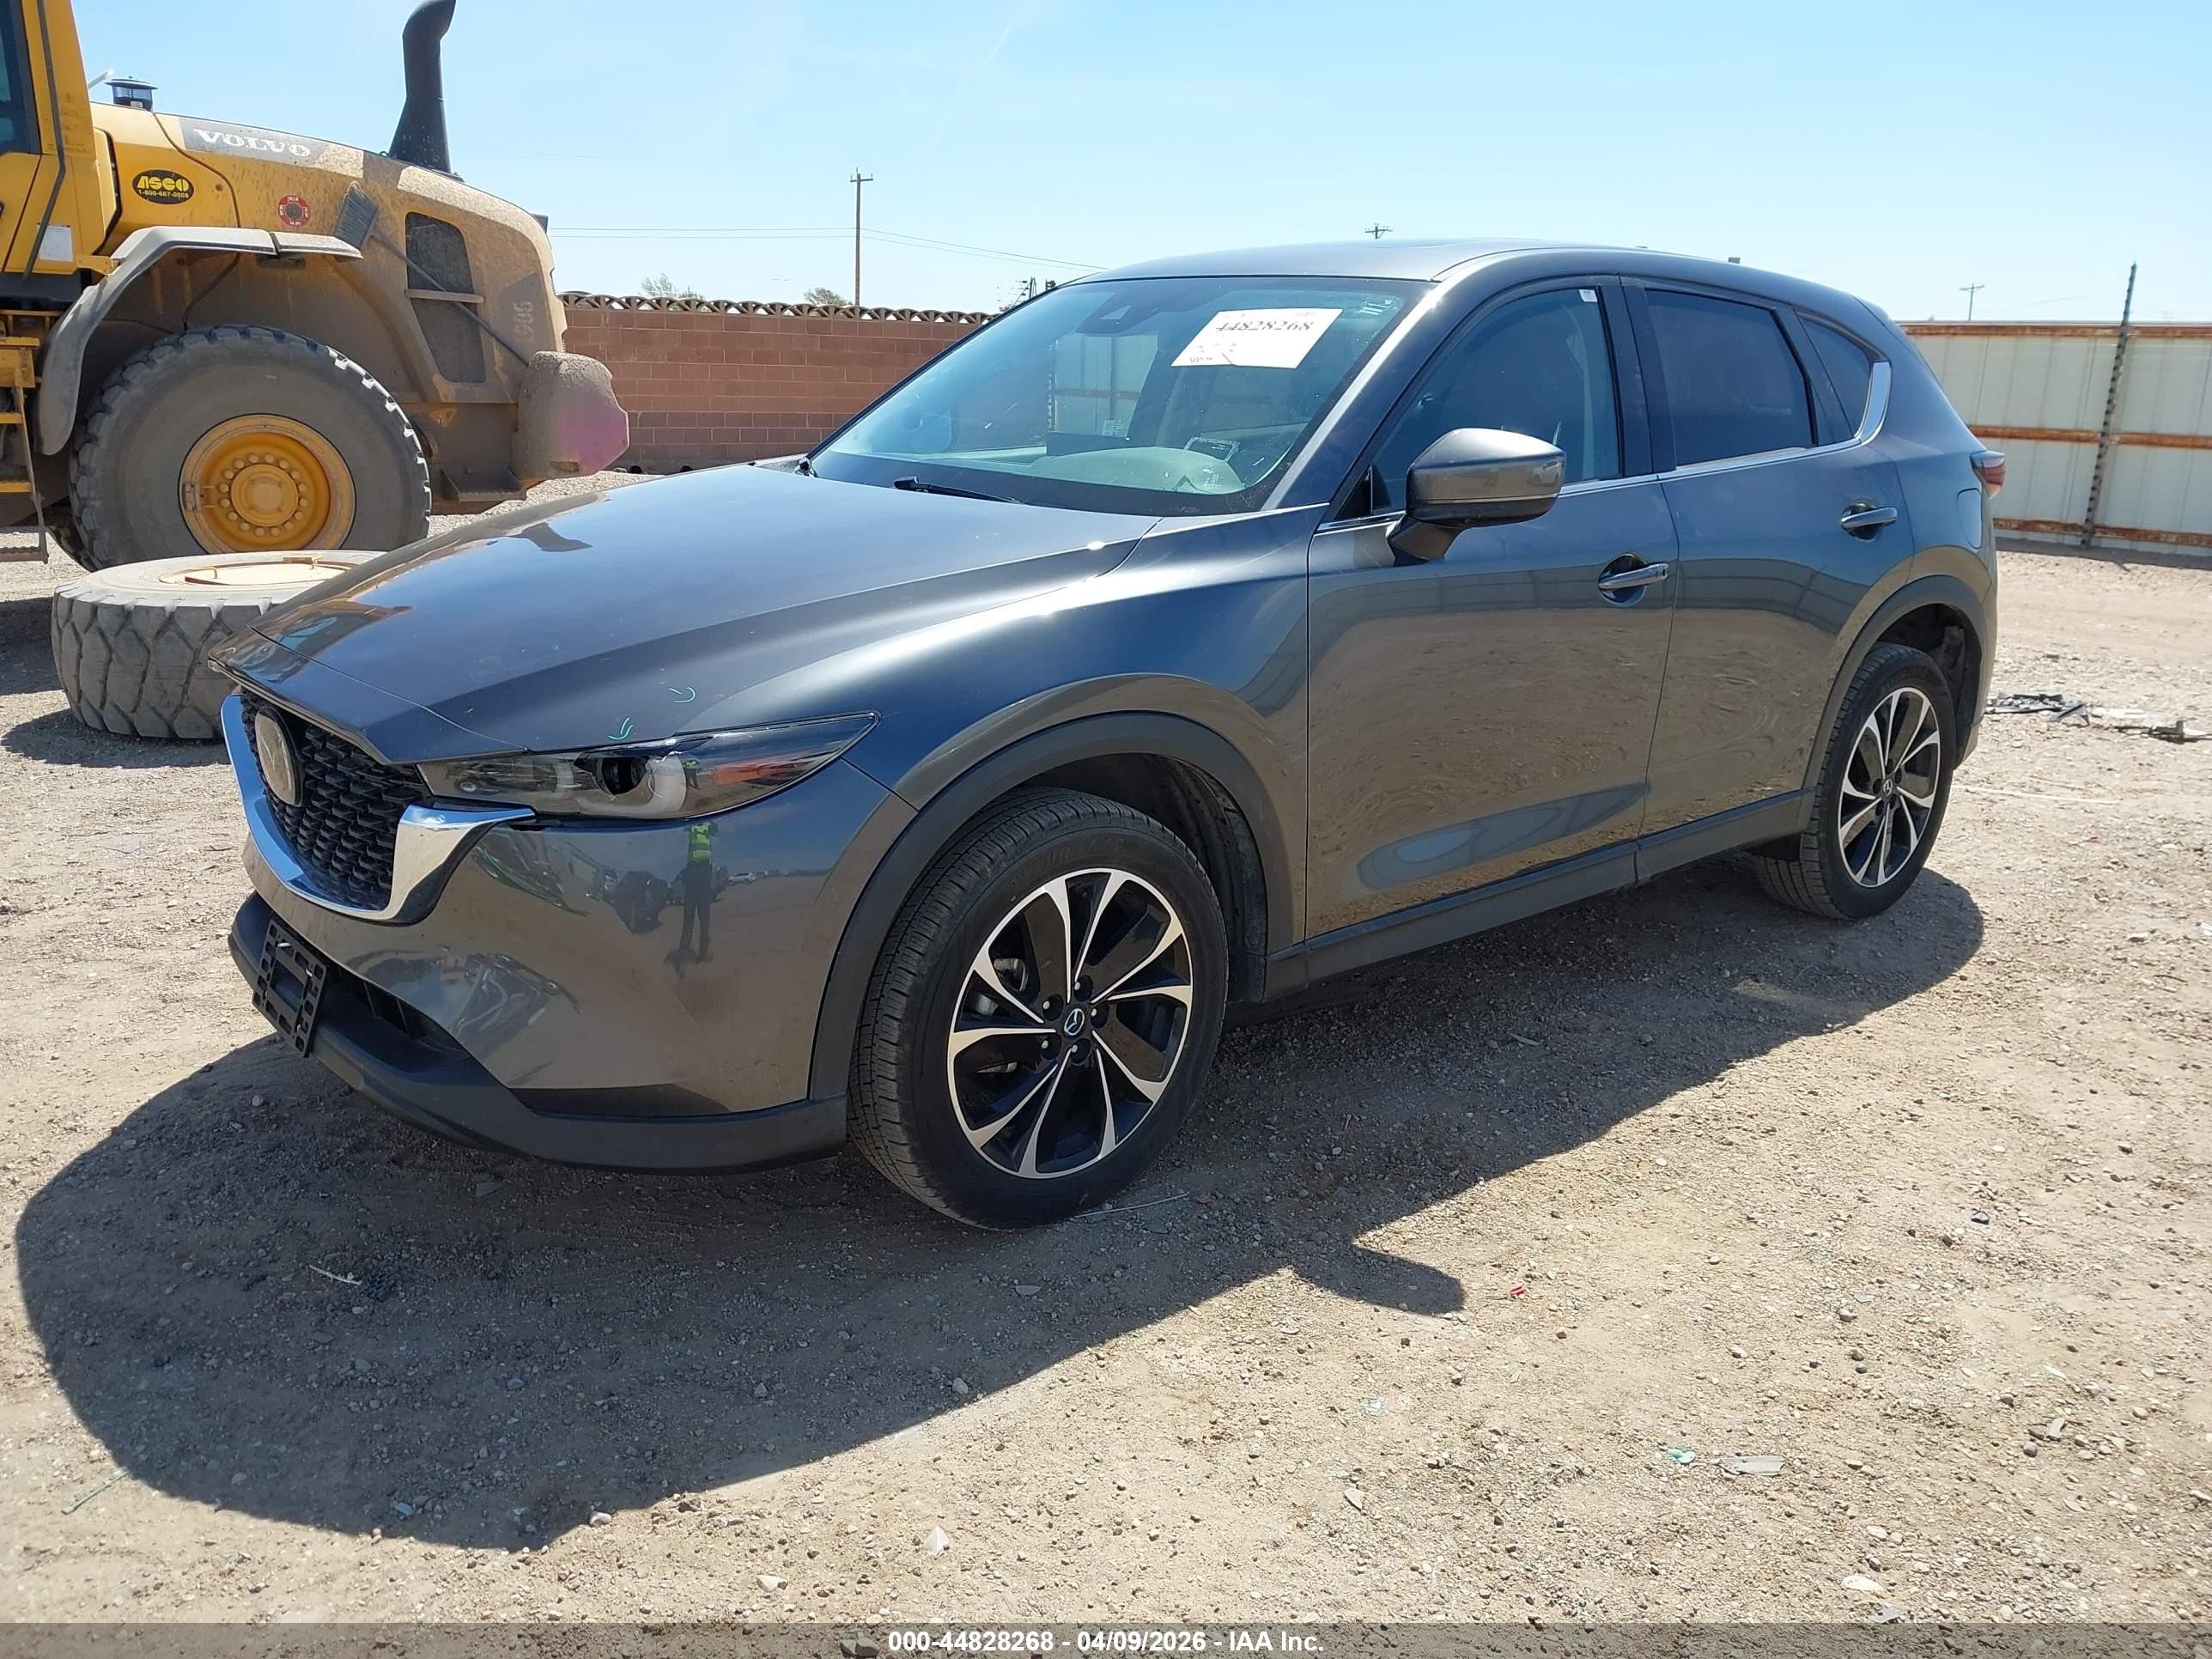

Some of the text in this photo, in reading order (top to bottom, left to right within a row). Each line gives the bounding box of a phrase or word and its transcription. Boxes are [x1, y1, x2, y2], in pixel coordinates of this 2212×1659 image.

[192, 128, 311, 157] VOLVO
[137, 175, 190, 191] ASCO
[1216, 320, 1315, 331] 44828268
